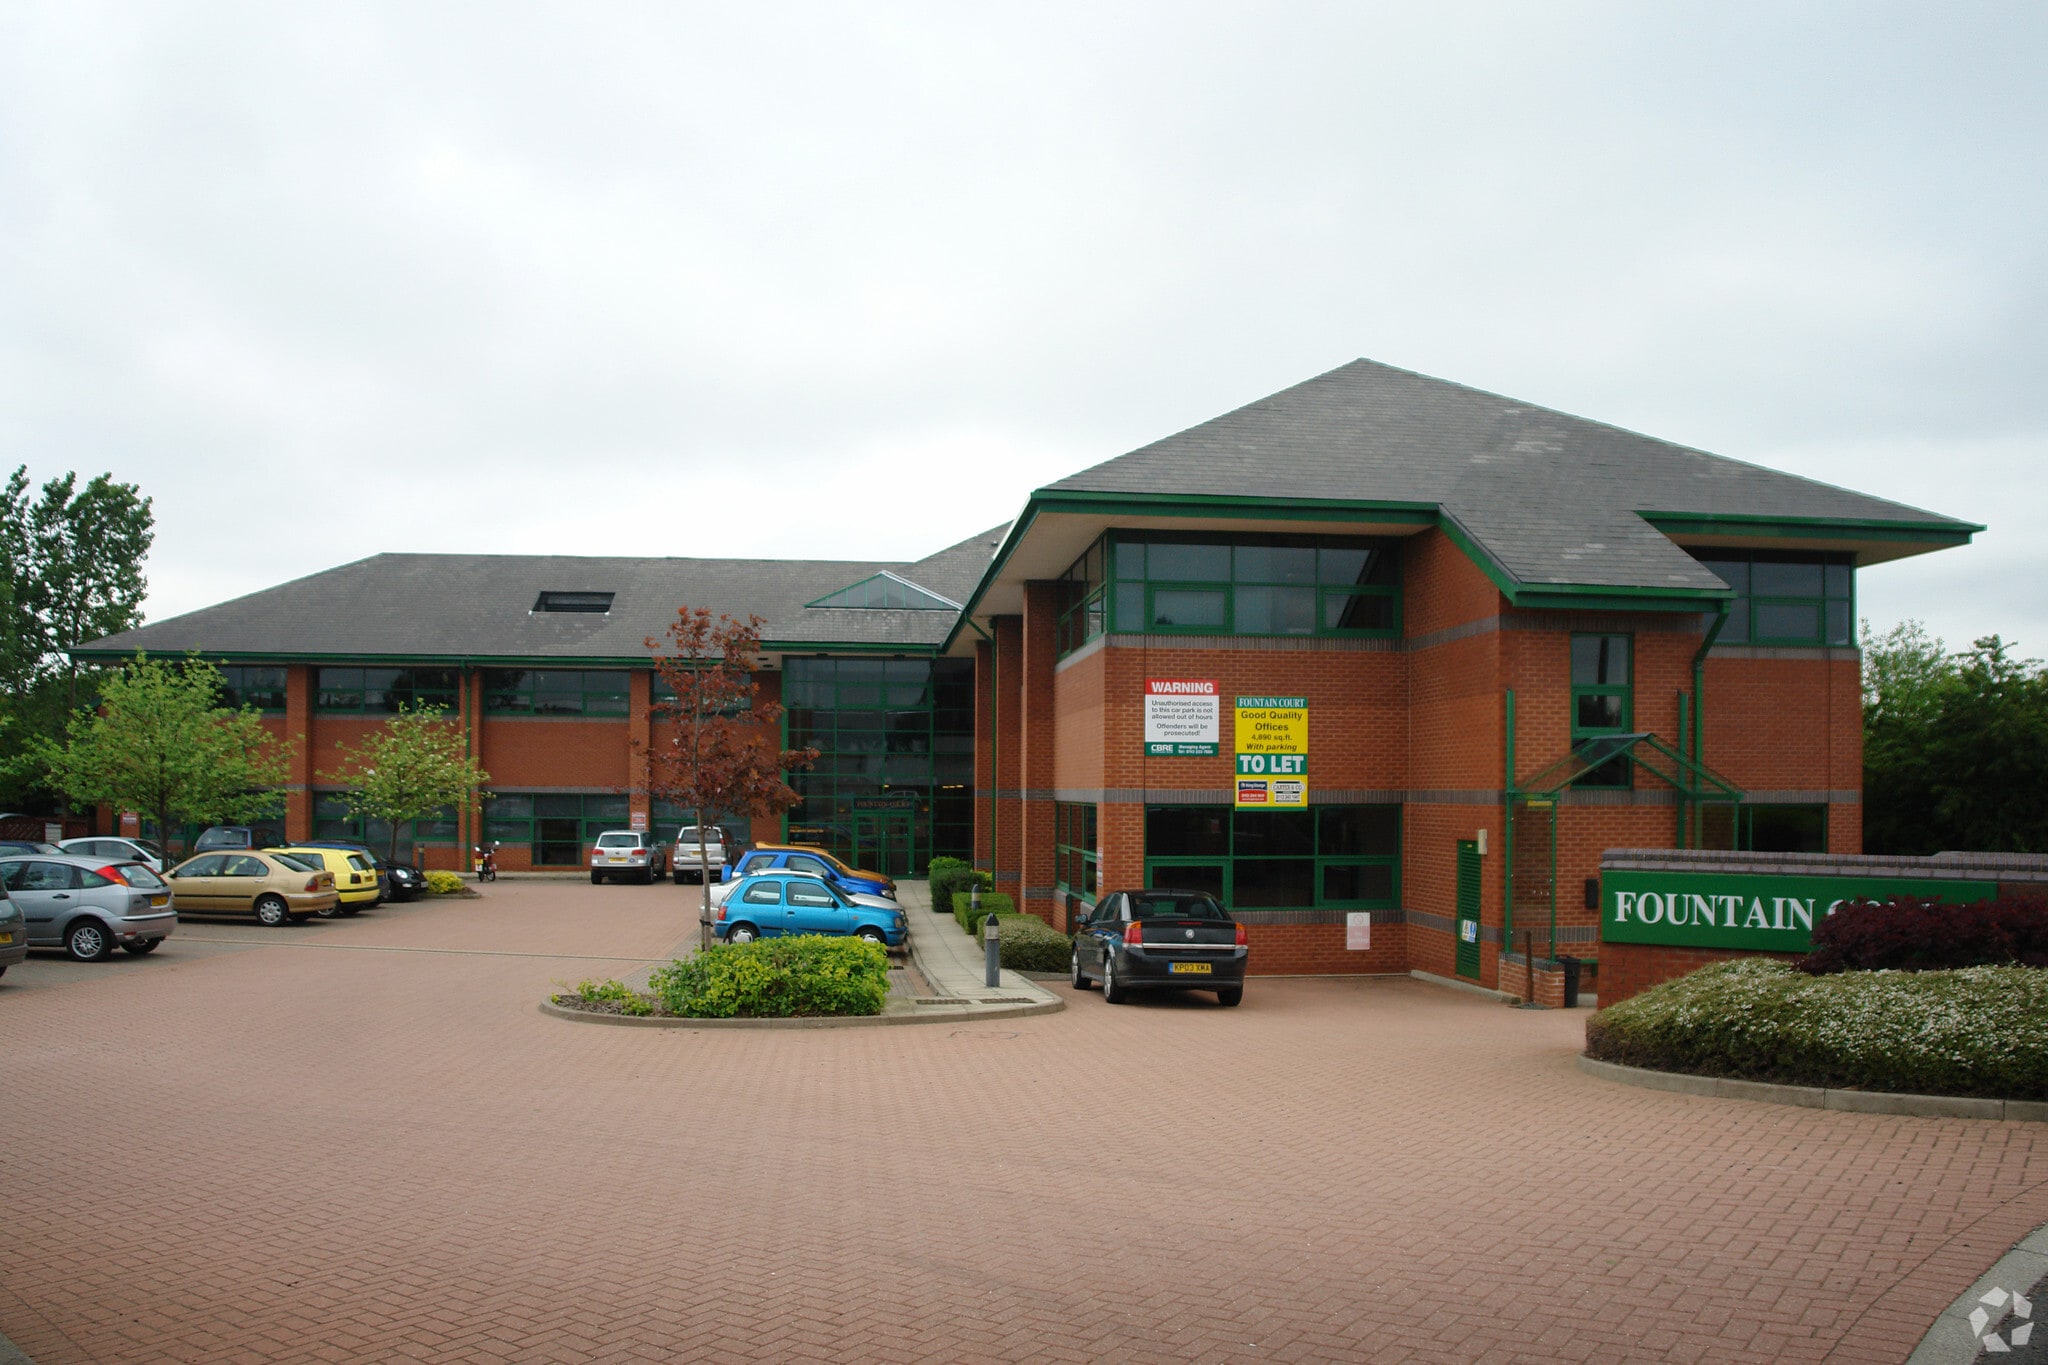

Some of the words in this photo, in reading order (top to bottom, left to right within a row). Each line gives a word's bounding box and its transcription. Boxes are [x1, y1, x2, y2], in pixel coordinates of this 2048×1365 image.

[1151, 682, 1213, 693] WARNING
[1239, 697, 1278, 707] FOUNTAIN
[1278, 698, 1305, 708] COURT
[1241, 710, 1267, 719] Good
[1269, 710, 1303, 721] Quality
[1255, 722, 1289, 731] Offices
[1265, 743, 1298, 752] parking
[1239, 755, 1265, 773] TO
[1271, 755, 1305, 773] LET
[1614, 891, 1817, 932] FOUNTAIN
